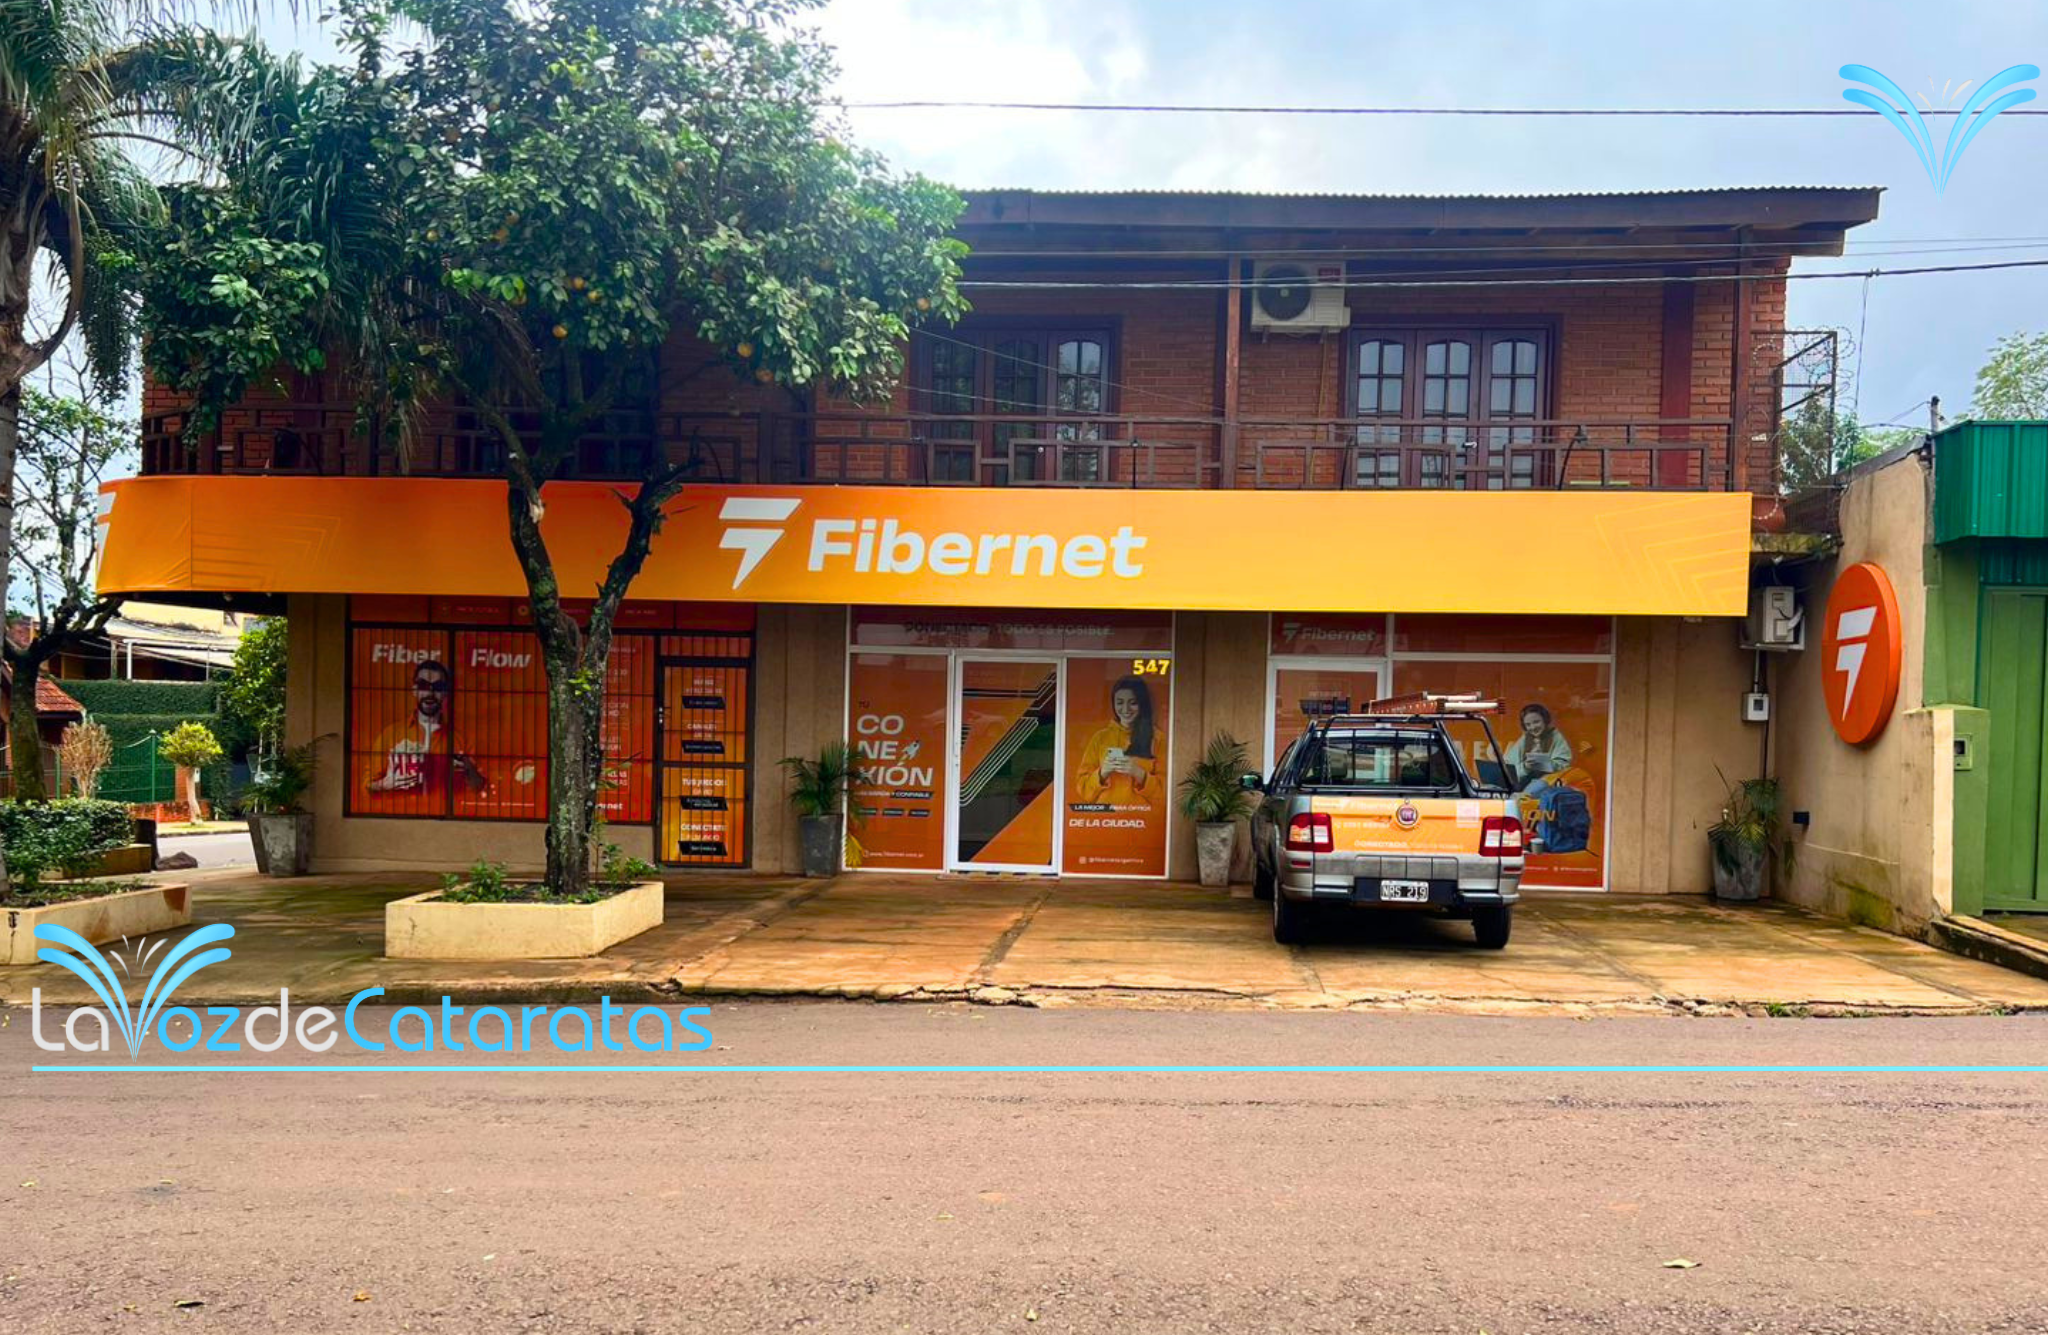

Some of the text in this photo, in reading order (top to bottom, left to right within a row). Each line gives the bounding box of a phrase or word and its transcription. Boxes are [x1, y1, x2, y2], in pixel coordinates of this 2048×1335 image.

[807, 517, 1148, 578] Fibernet
[1301, 627, 1377, 641] Fibernet
[372, 643, 441, 664] Fiber
[471, 648, 532, 668] Flow
[1132, 659, 1170, 676] 547
[856, 714, 905, 735] CO
[858, 740, 899, 760] NE
[1069, 819, 1084, 828] DE
[1086, 819, 1101, 828] LA
